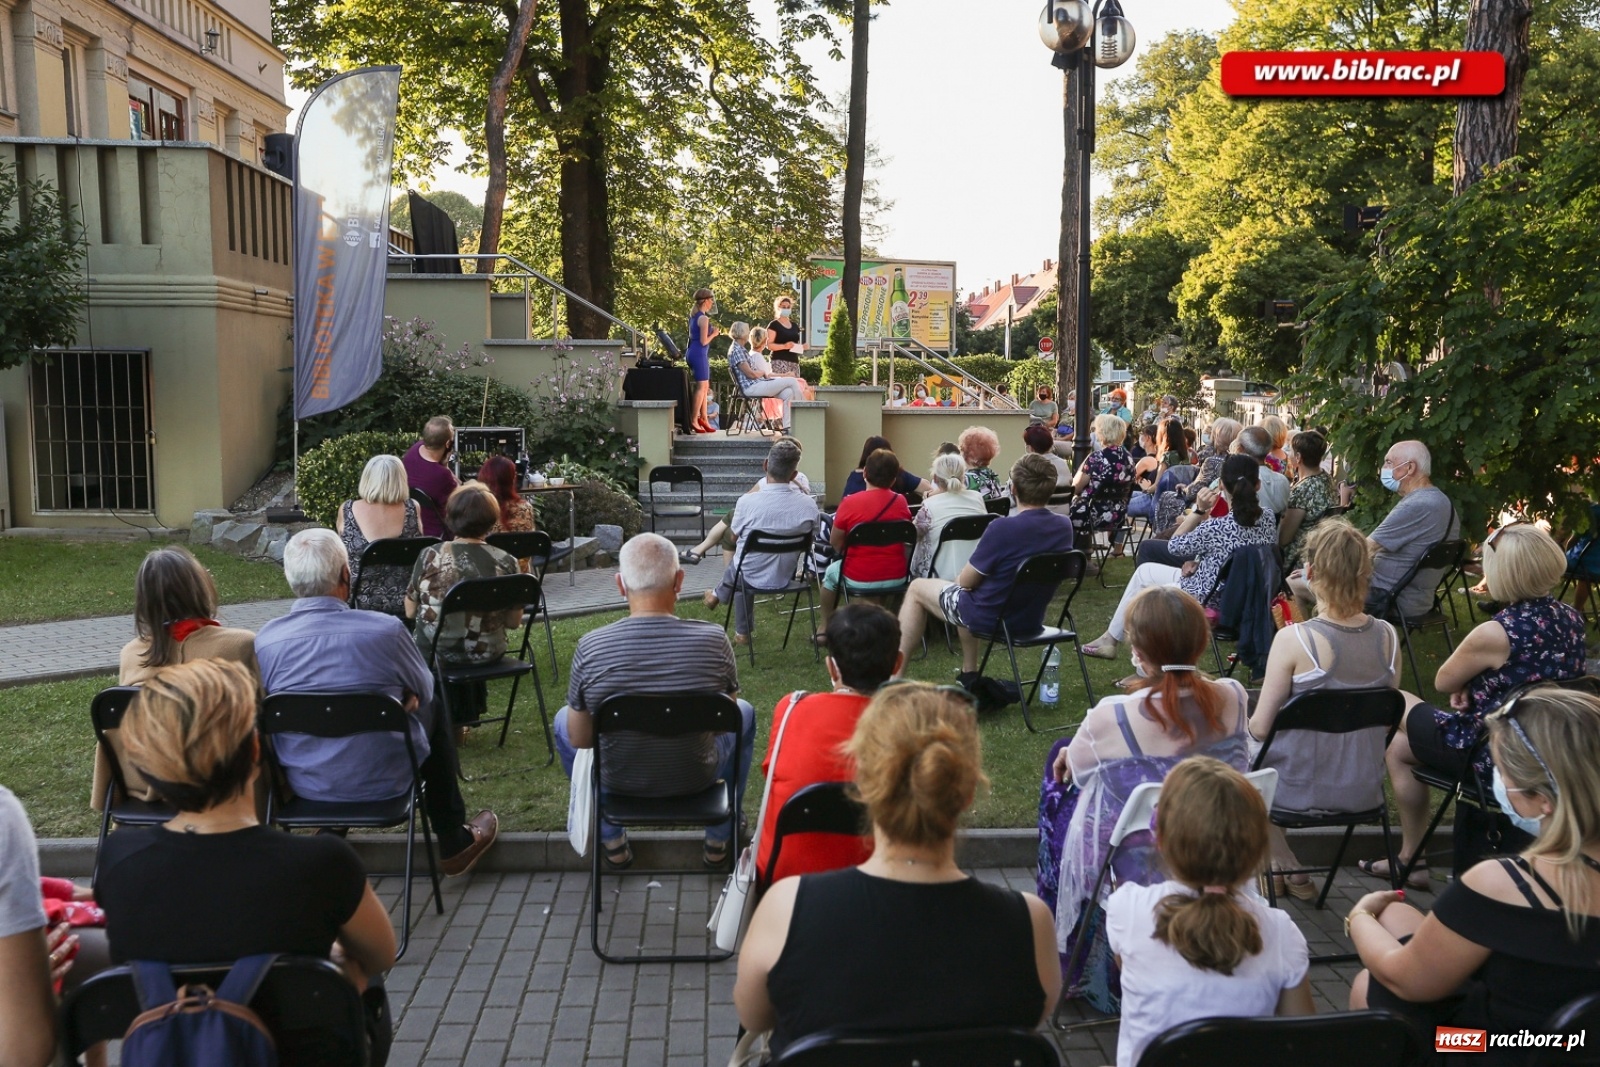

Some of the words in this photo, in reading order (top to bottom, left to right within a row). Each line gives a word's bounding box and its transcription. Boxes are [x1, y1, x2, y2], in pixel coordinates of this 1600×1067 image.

[860, 286, 873, 334] WYPASIONE
[874, 286, 887, 334] WYPASIONE
[311, 274, 335, 399] BIBLIOTEKA
